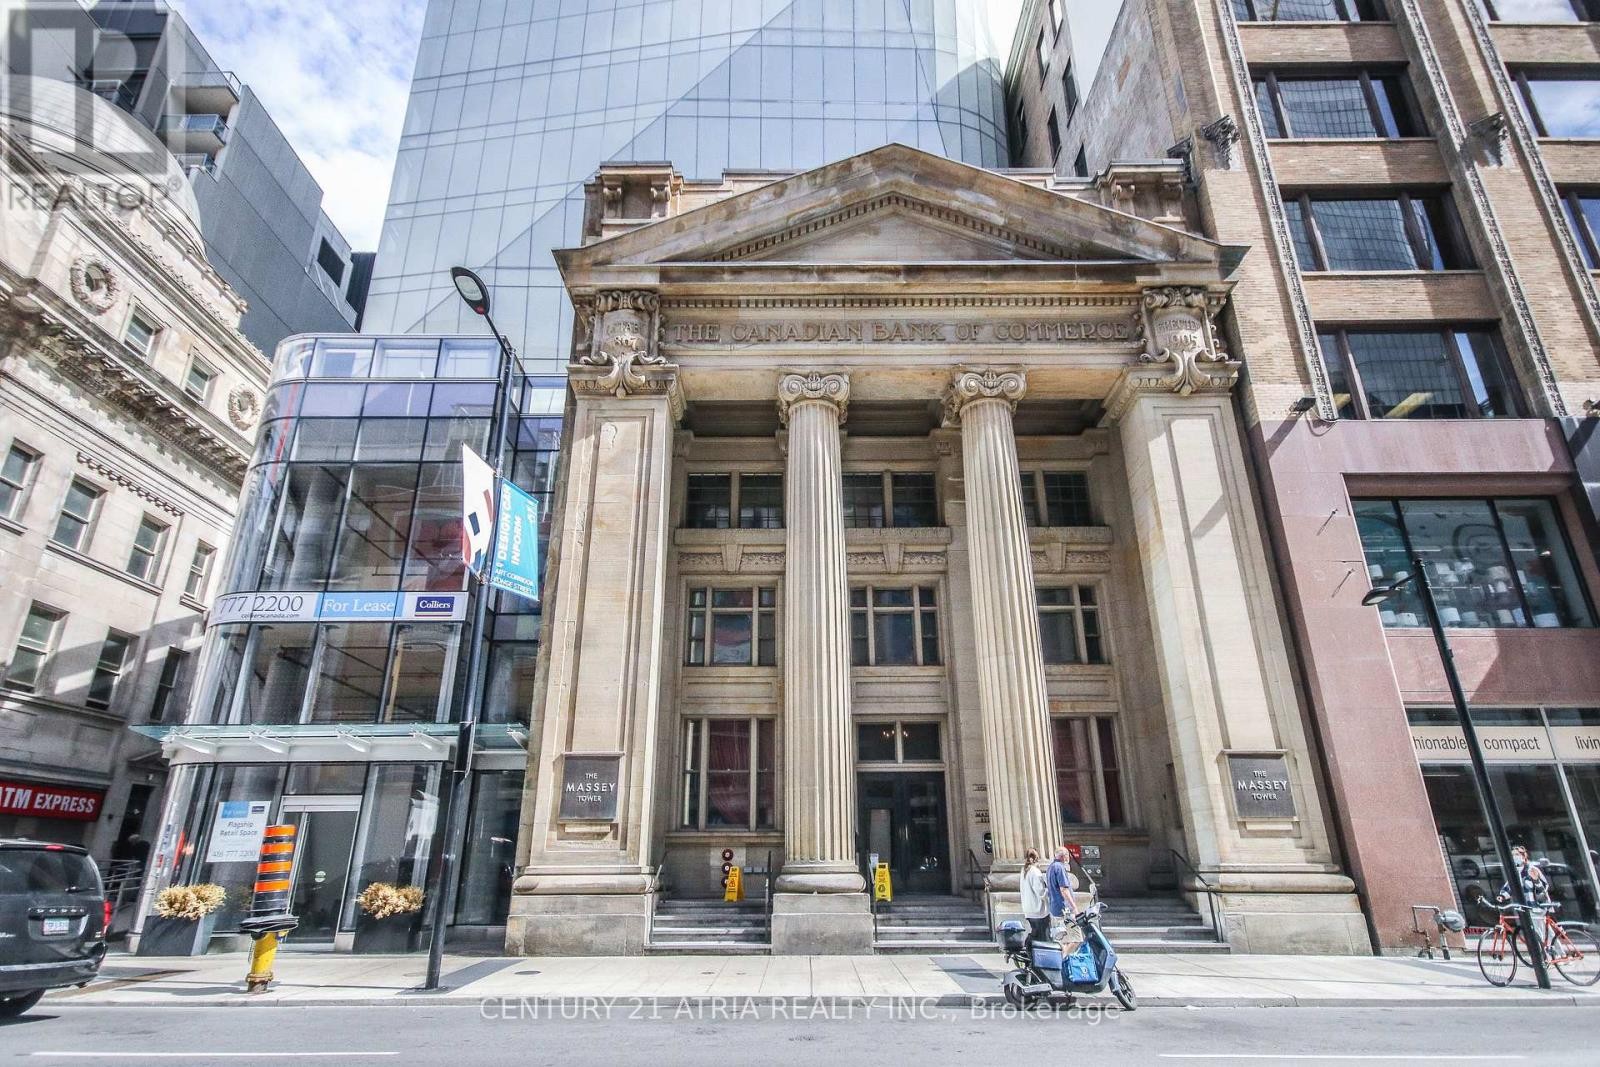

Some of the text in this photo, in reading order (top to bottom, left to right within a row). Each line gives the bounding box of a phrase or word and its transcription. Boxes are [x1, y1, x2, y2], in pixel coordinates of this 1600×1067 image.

[674, 321, 1129, 342] THE CANADIAN BANK OF COMMERCE
[497, 514, 511, 561] DESIGN
[511, 514, 522, 566] INFORM
[220, 595, 303, 613] 777 2200
[322, 599, 394, 612] For Lease
[420, 600, 451, 608] Colliers
[1483, 737, 1540, 752] compact
[565, 783, 616, 792] MASSEY
[1237, 780, 1287, 790] MASSEY
[34, 793, 95, 813] EXPRESS
